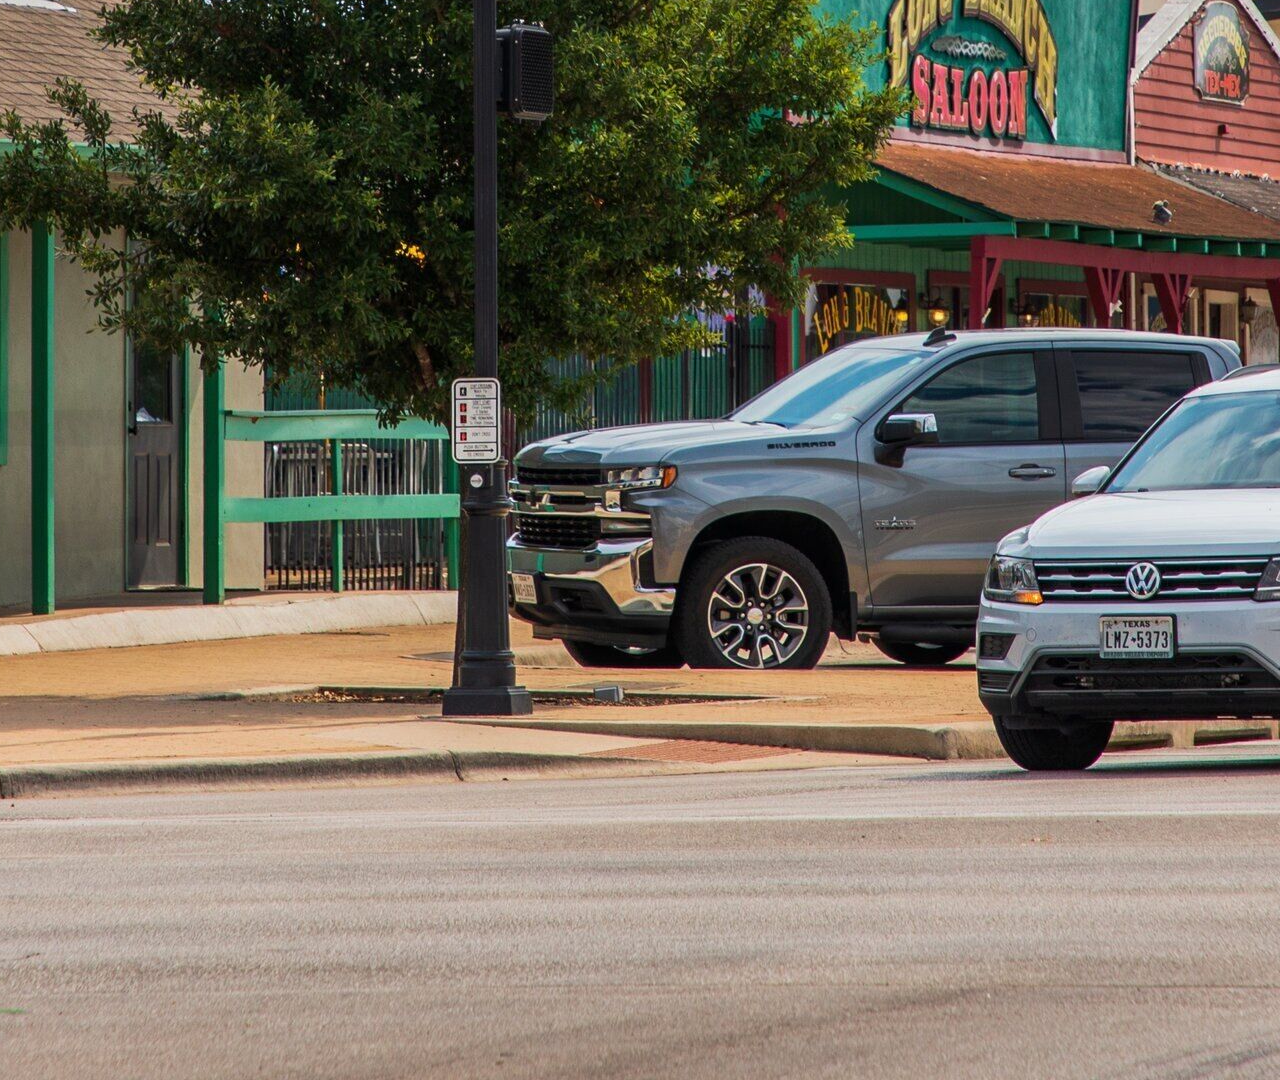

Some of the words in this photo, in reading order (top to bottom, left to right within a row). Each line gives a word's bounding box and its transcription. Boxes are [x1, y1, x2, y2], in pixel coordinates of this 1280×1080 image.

[913, 55, 1028, 135] SALOON
[814, 291, 850, 355] LONG
[767, 440, 836, 450] SILVERADO
[1123, 620, 1150, 628] TEXAS
